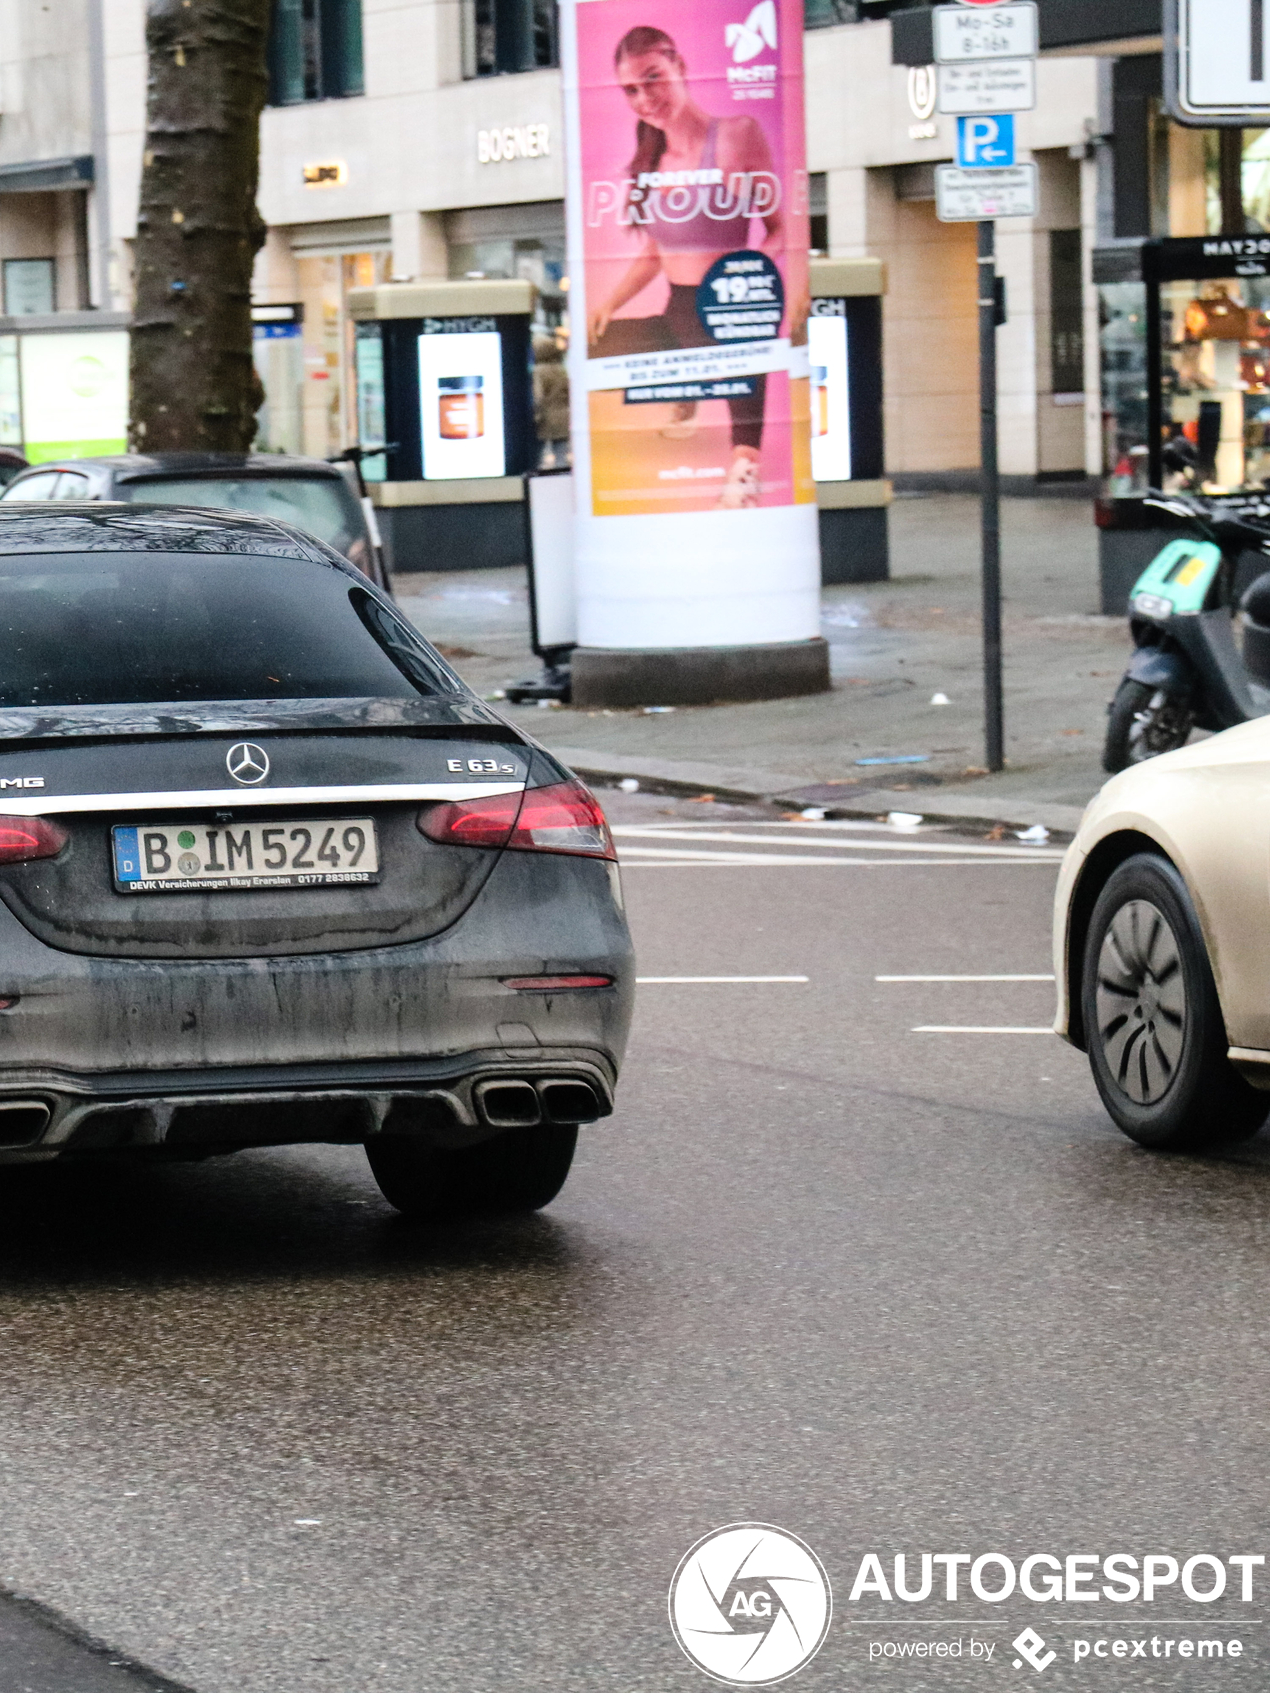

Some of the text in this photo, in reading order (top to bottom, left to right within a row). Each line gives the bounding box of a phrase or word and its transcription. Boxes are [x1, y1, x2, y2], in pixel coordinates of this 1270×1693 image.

[478, 123, 549, 163] BOGNER
[964, 117, 999, 162] P
[638, 168, 723, 188] FOREVER
[587, 171, 781, 227] PROUD
[447, 759, 463, 772] E
[123, 860, 134, 873] D
[143, 832, 172, 874] B
[129, 880, 157, 891] DEVK
[158, 877, 228, 890] Versicherungen
[297, 873, 323, 884] 0177
